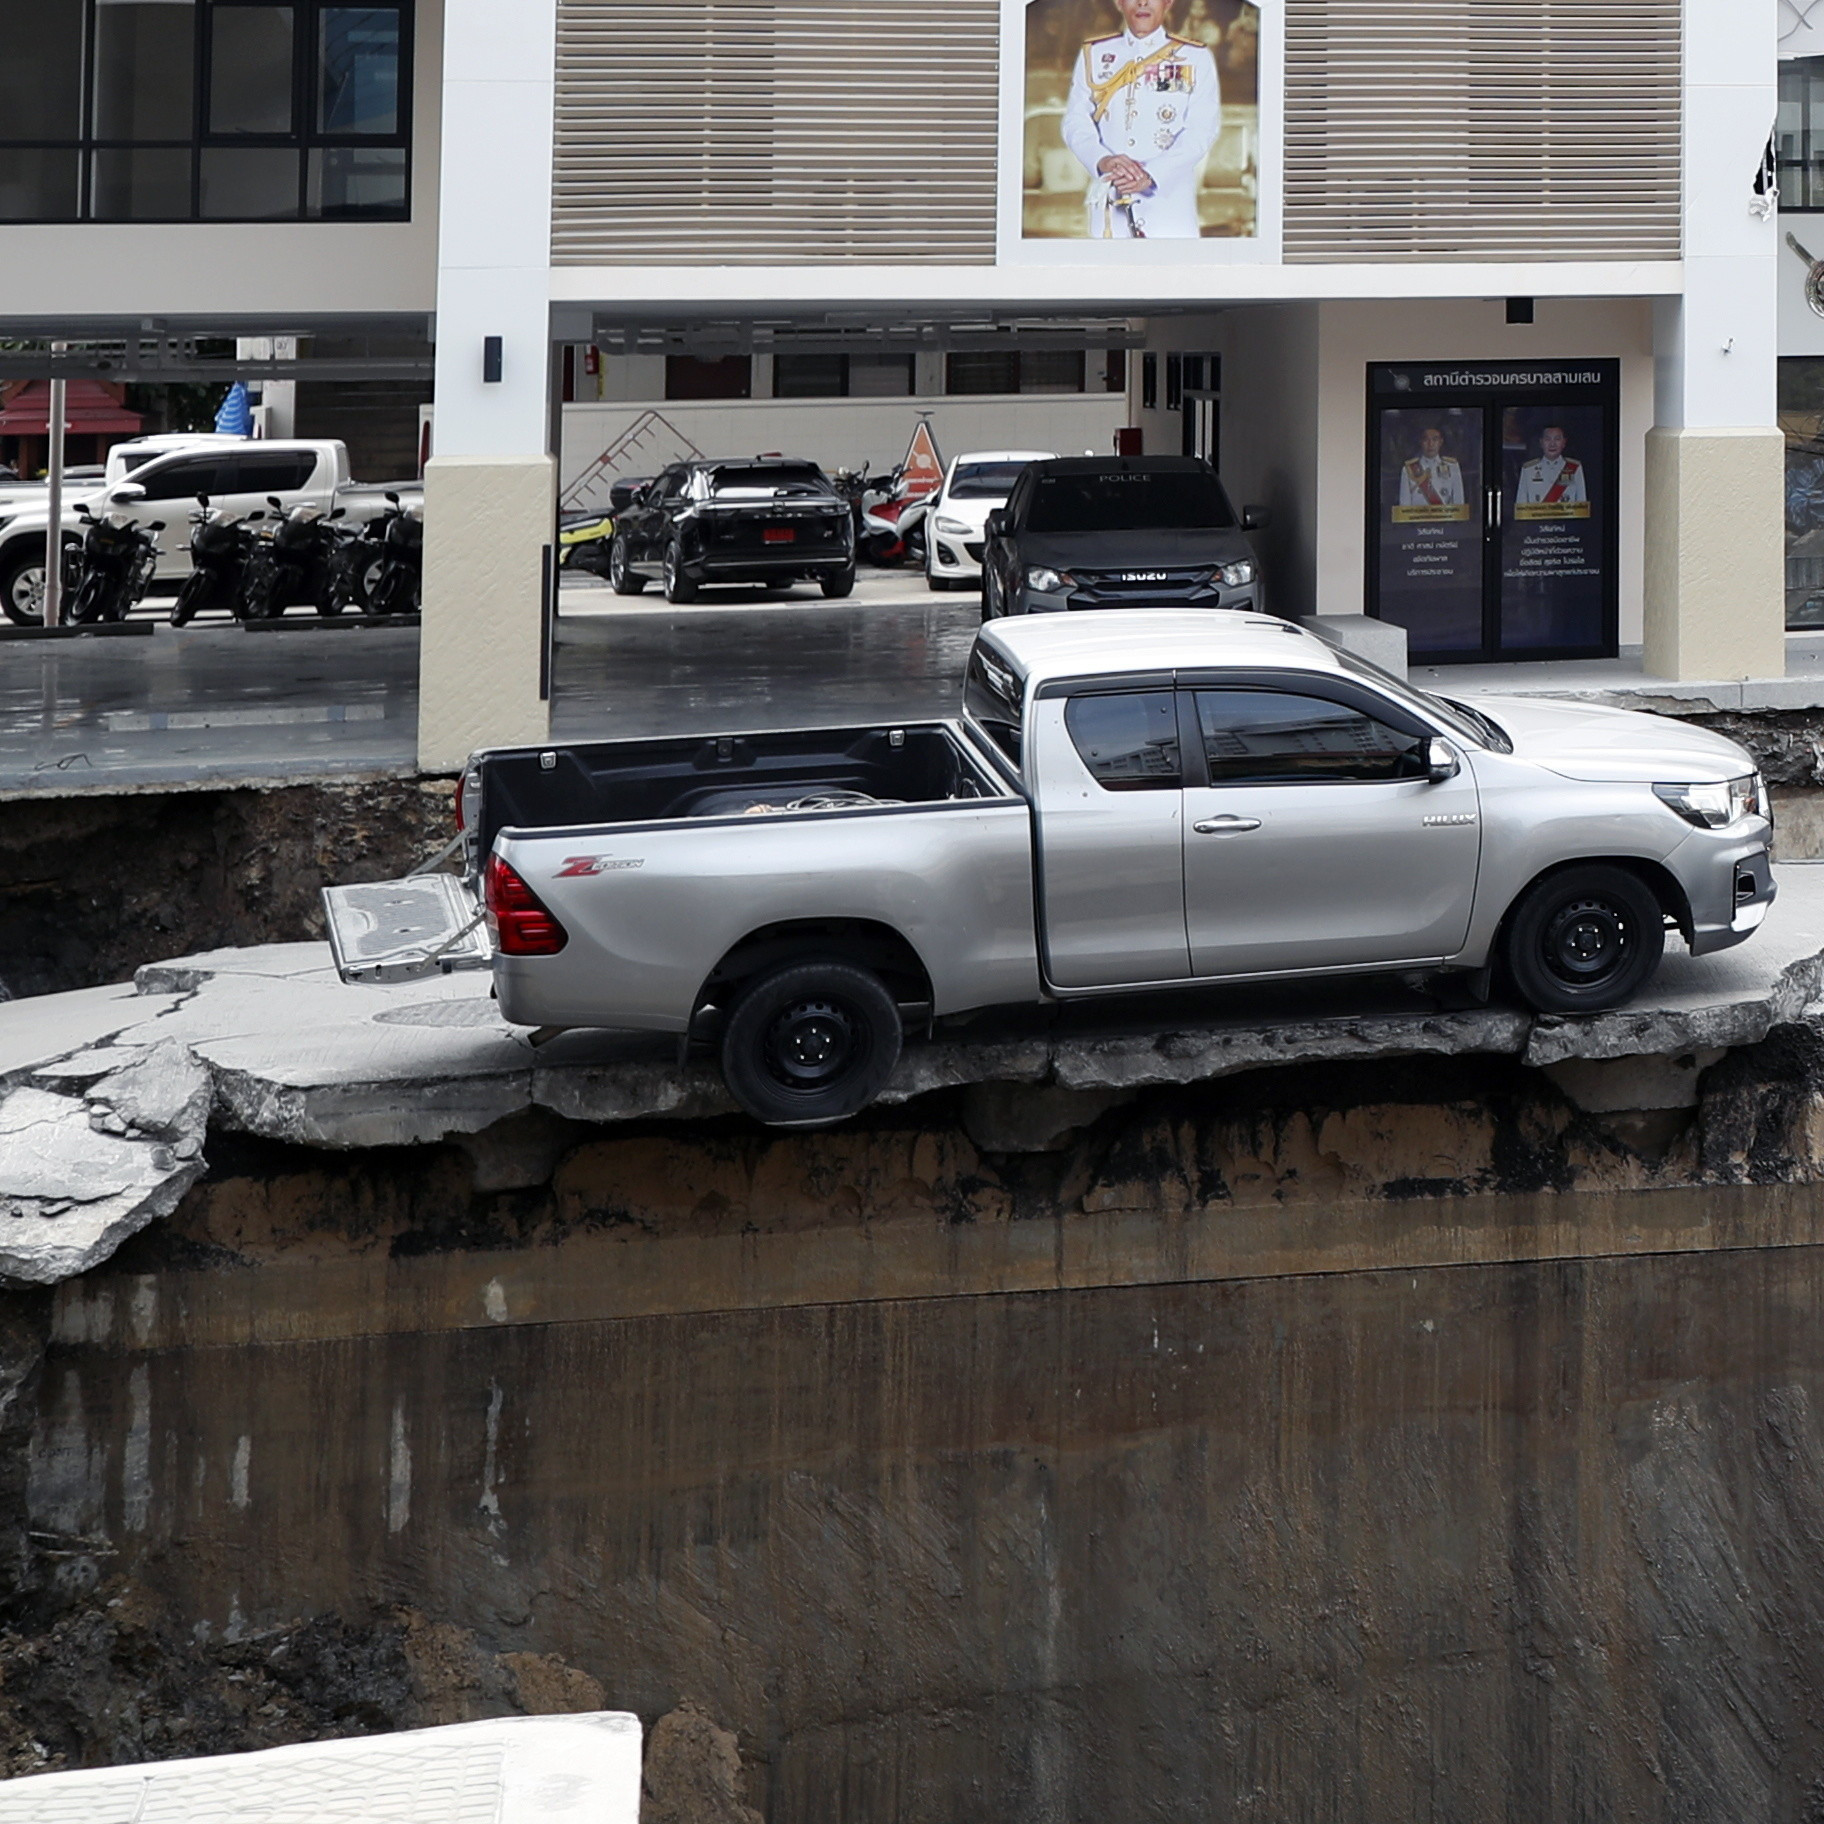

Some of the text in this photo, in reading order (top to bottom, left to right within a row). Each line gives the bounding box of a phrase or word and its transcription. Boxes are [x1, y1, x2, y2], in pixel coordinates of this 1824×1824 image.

[1423, 370, 1601, 387] สถานีตำรวจนครบาลสามเสน
[1099, 474, 1152, 482] POLICE
[1121, 572, 1167, 581] ISUZU
[1422, 813, 1477, 826] HILUX
